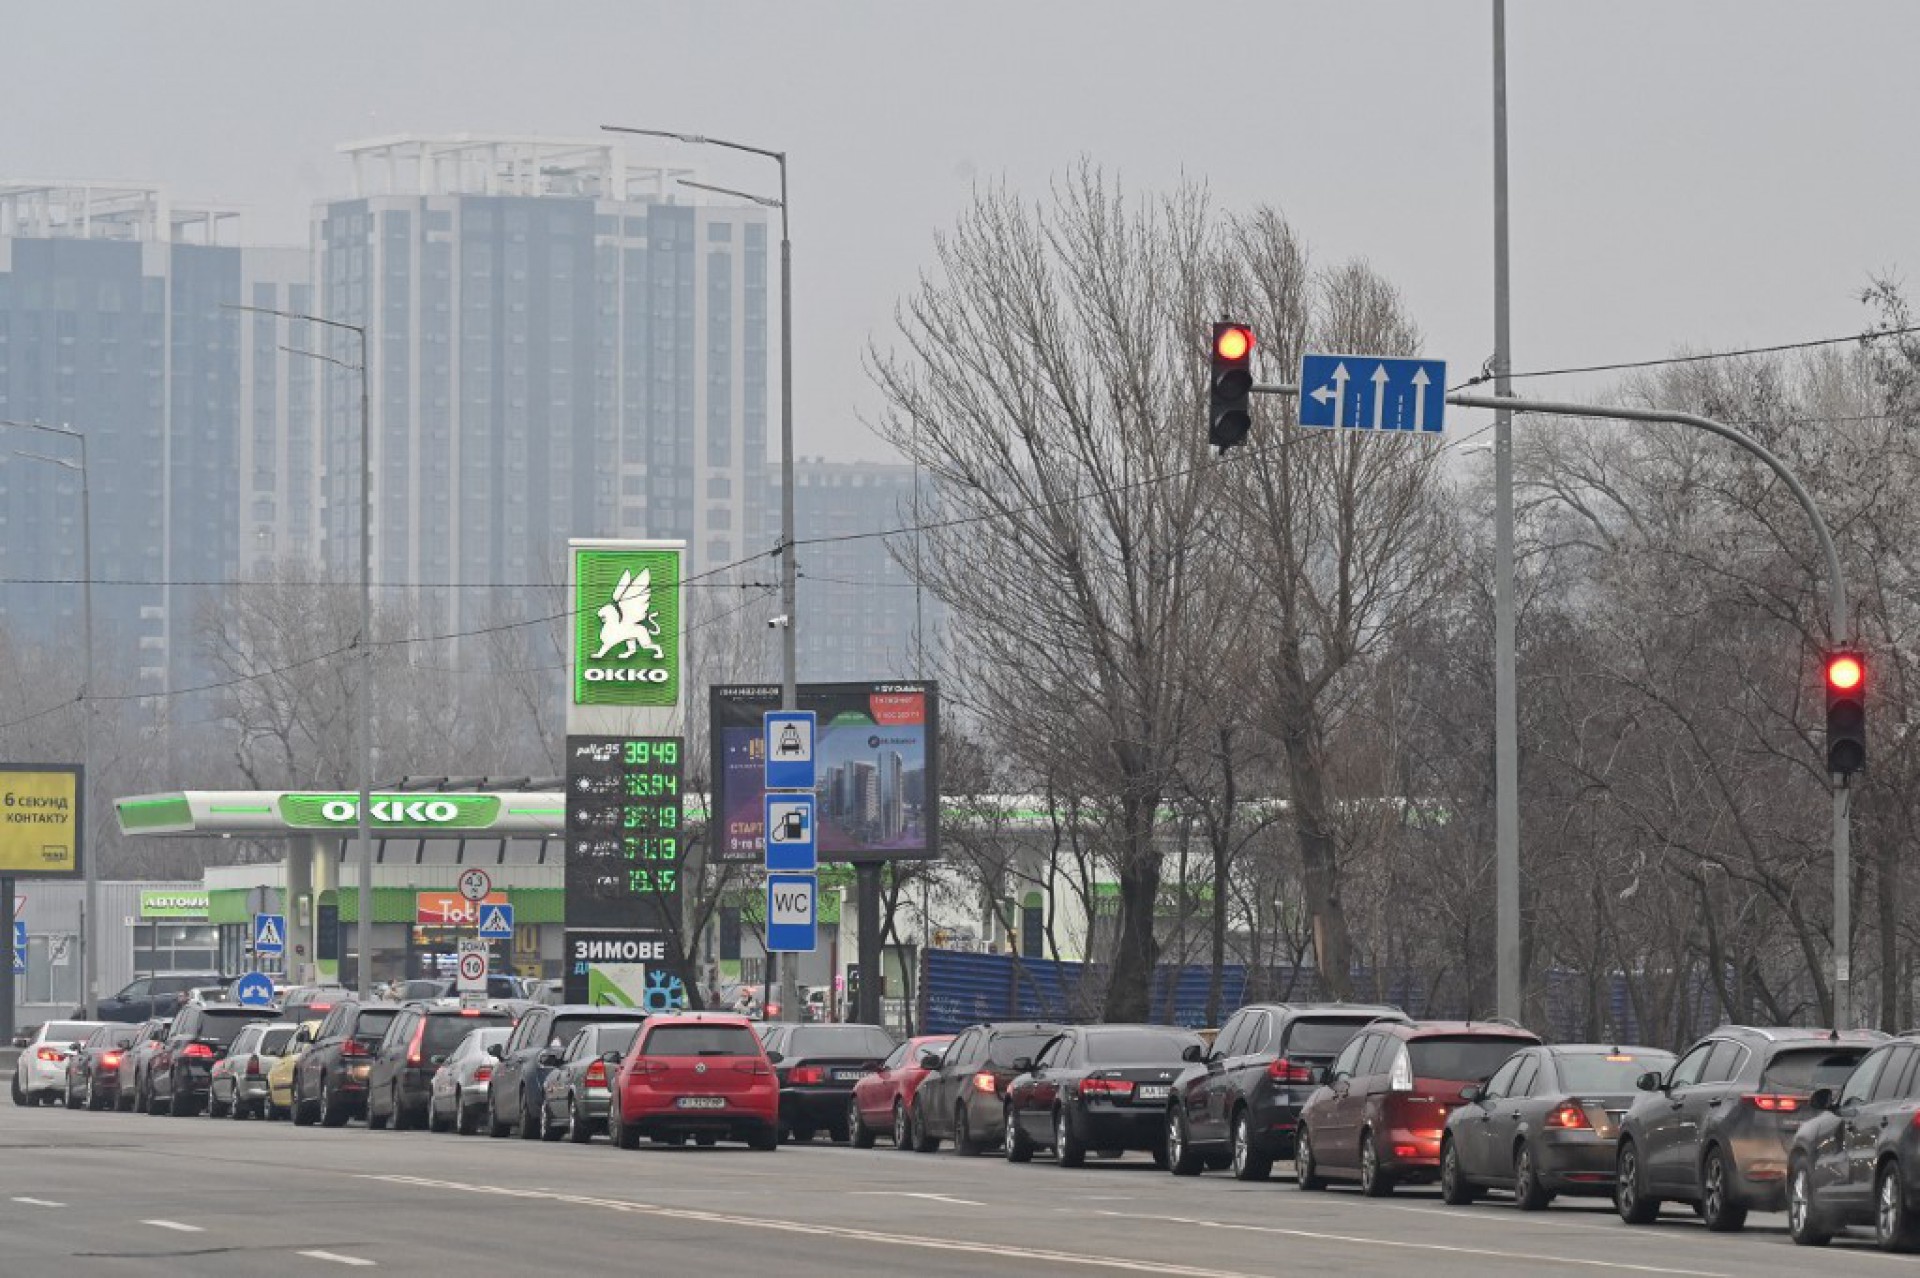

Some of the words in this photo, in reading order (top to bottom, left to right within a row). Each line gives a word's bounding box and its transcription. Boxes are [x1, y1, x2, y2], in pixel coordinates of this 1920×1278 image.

[584, 668, 669, 683] OKKO
[4, 792, 15, 807] 6
[18, 796, 69, 810] СЕКУНД
[7, 812, 69, 824] КОНТАКТУ
[321, 801, 459, 822] OKKO
[774, 893, 808, 914] WC
[574, 940, 665, 960] ЗИМОВЕ
[465, 960, 481, 973] 10
